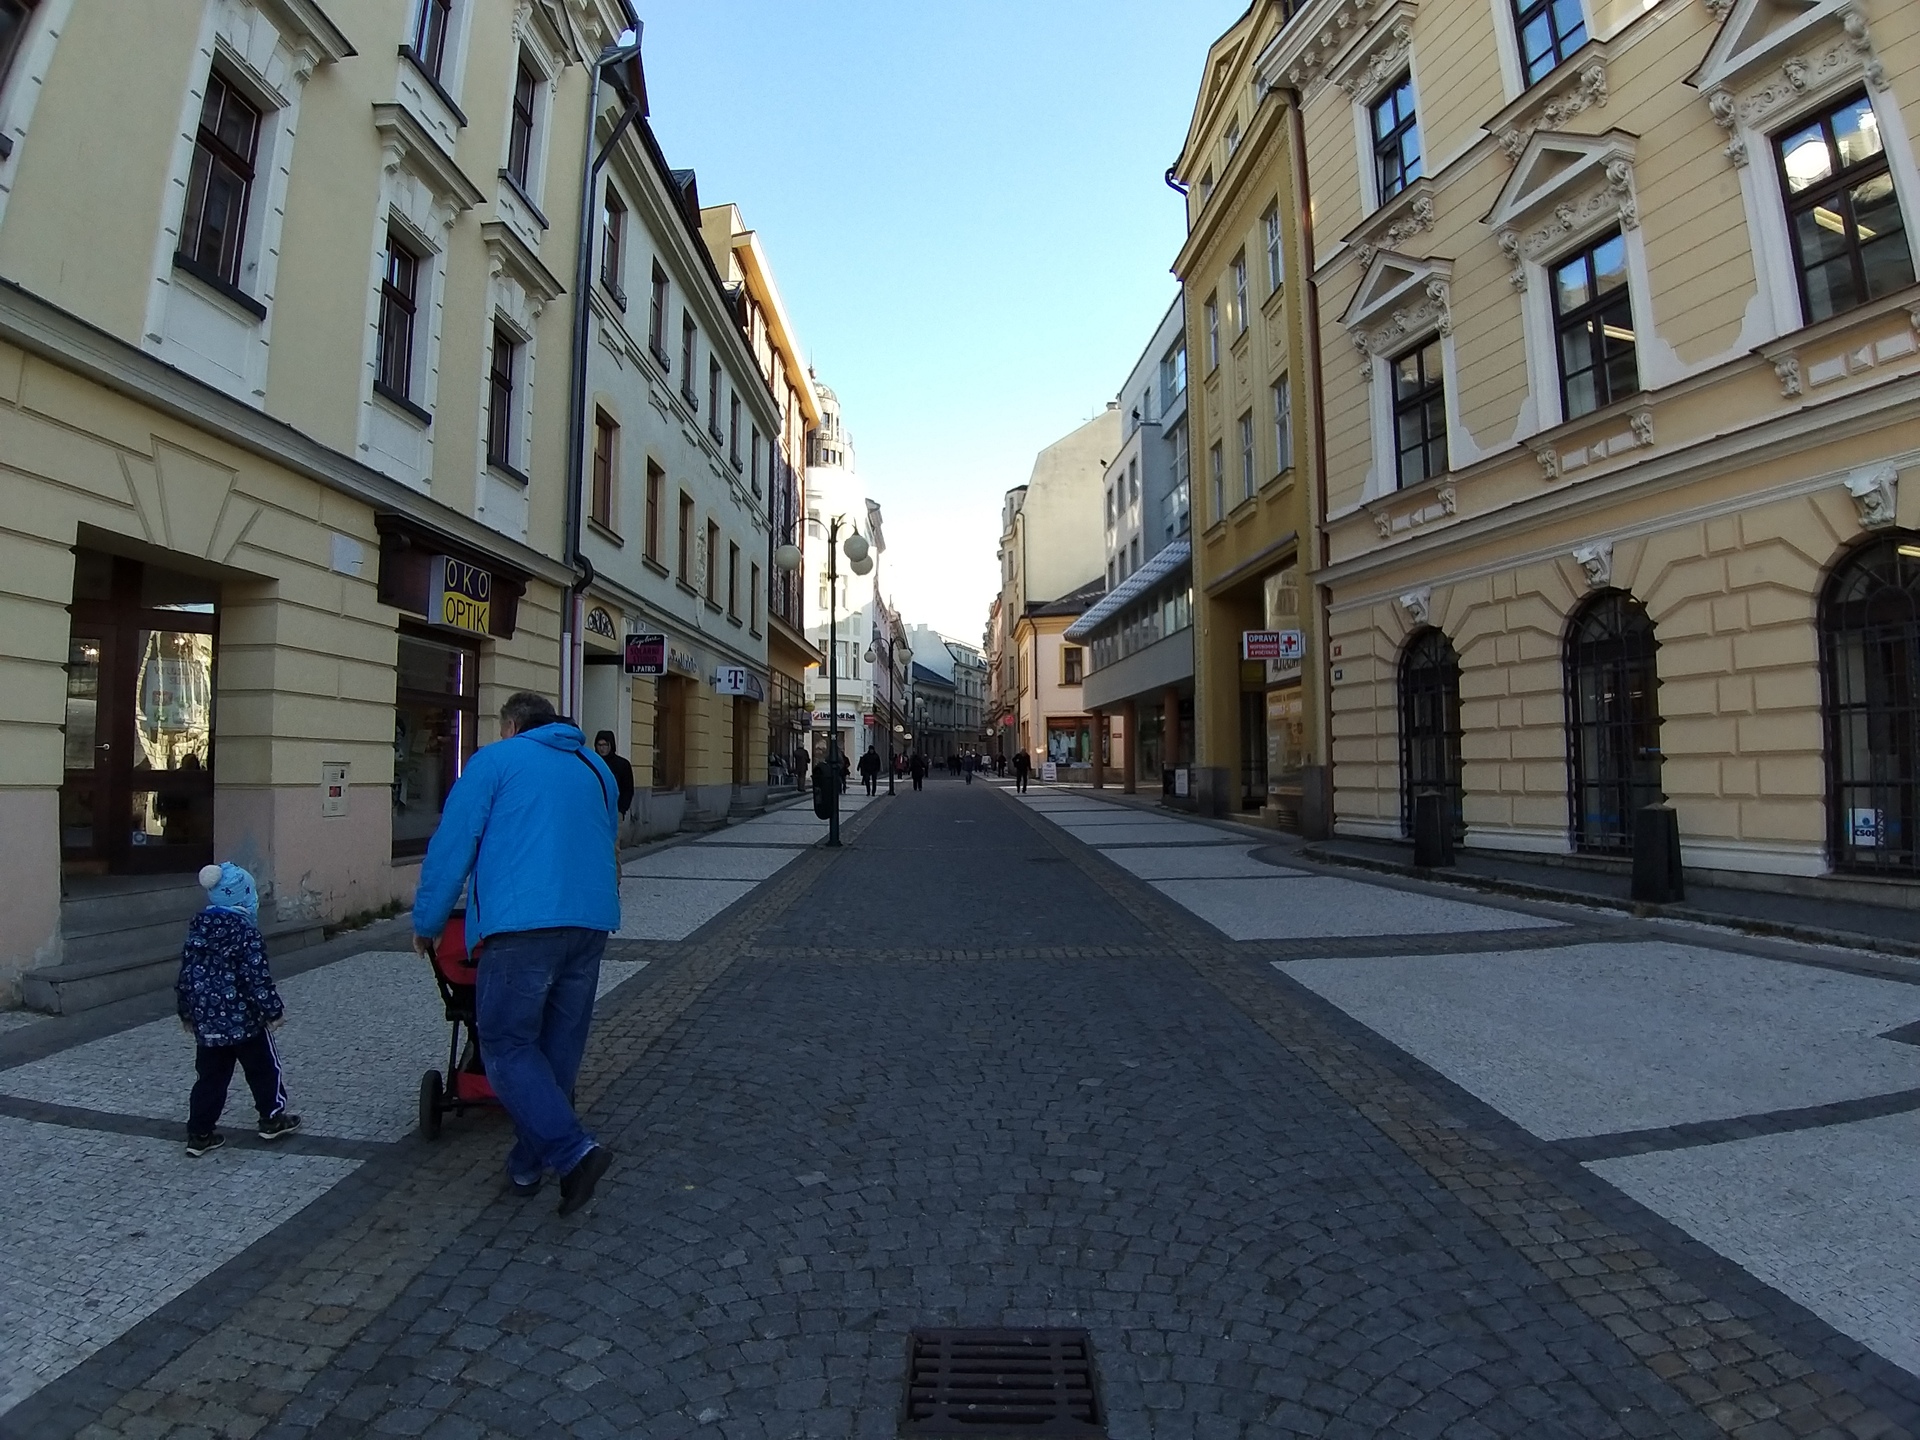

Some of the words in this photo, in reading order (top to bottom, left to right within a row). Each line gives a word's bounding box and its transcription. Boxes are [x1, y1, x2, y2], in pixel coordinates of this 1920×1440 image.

[447, 560, 488, 598] OKO
[446, 597, 487, 634] OPTIK
[1248, 634, 1277, 643] OPRAVY
[632, 665, 656, 673] 1.PATRO
[728, 669, 744, 690] T
